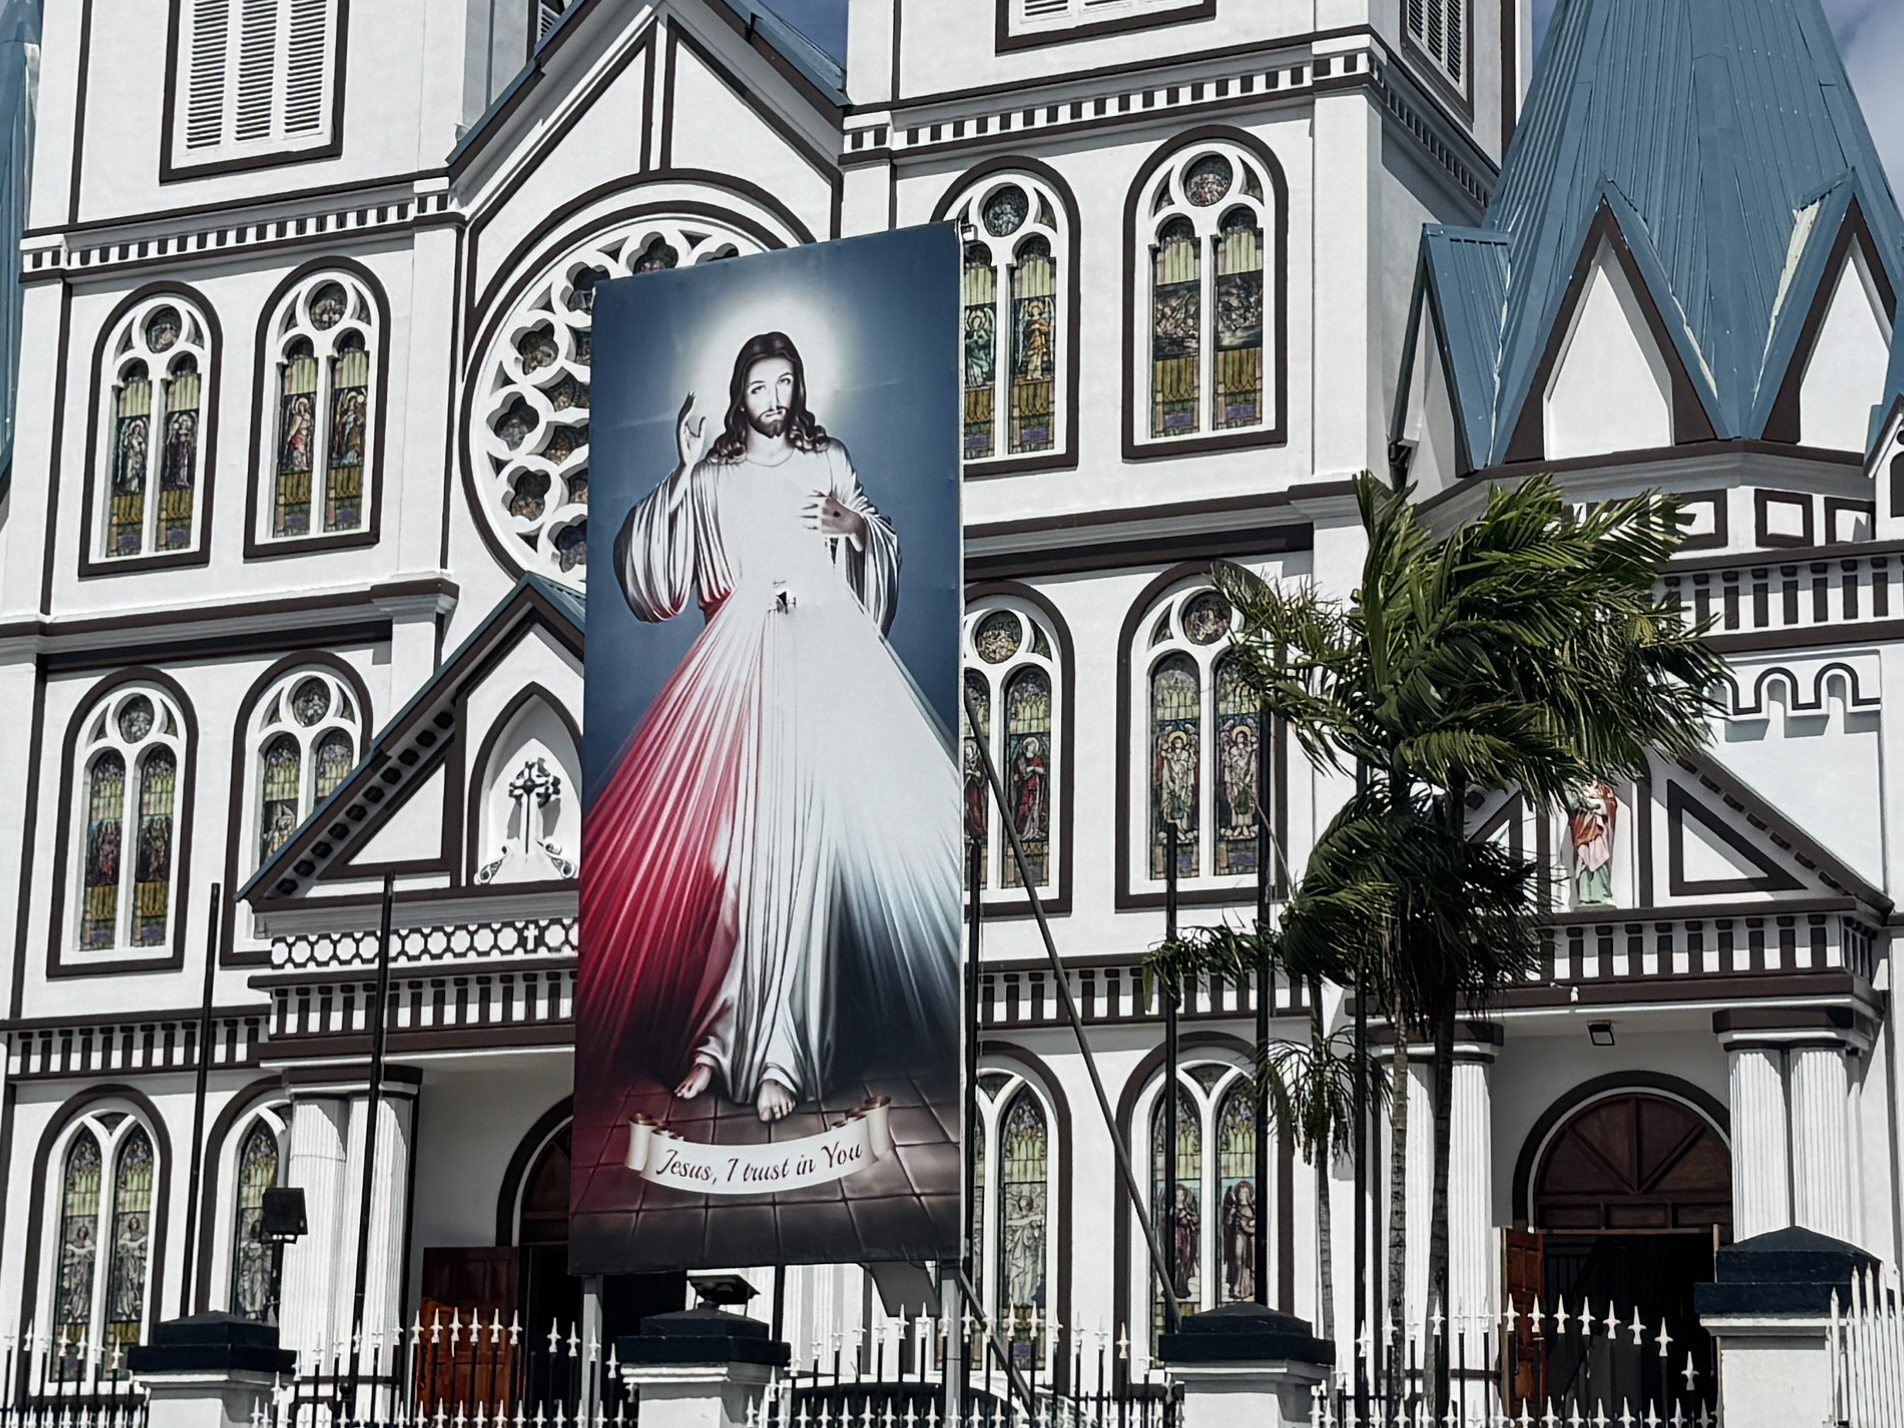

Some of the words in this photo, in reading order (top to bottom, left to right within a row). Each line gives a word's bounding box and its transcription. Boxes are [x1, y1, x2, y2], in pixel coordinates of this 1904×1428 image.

[656, 1148, 717, 1185] Jesus,
[743, 1158, 789, 1182] trust
[796, 1154, 816, 1175] in
[821, 1141, 863, 1169] You
